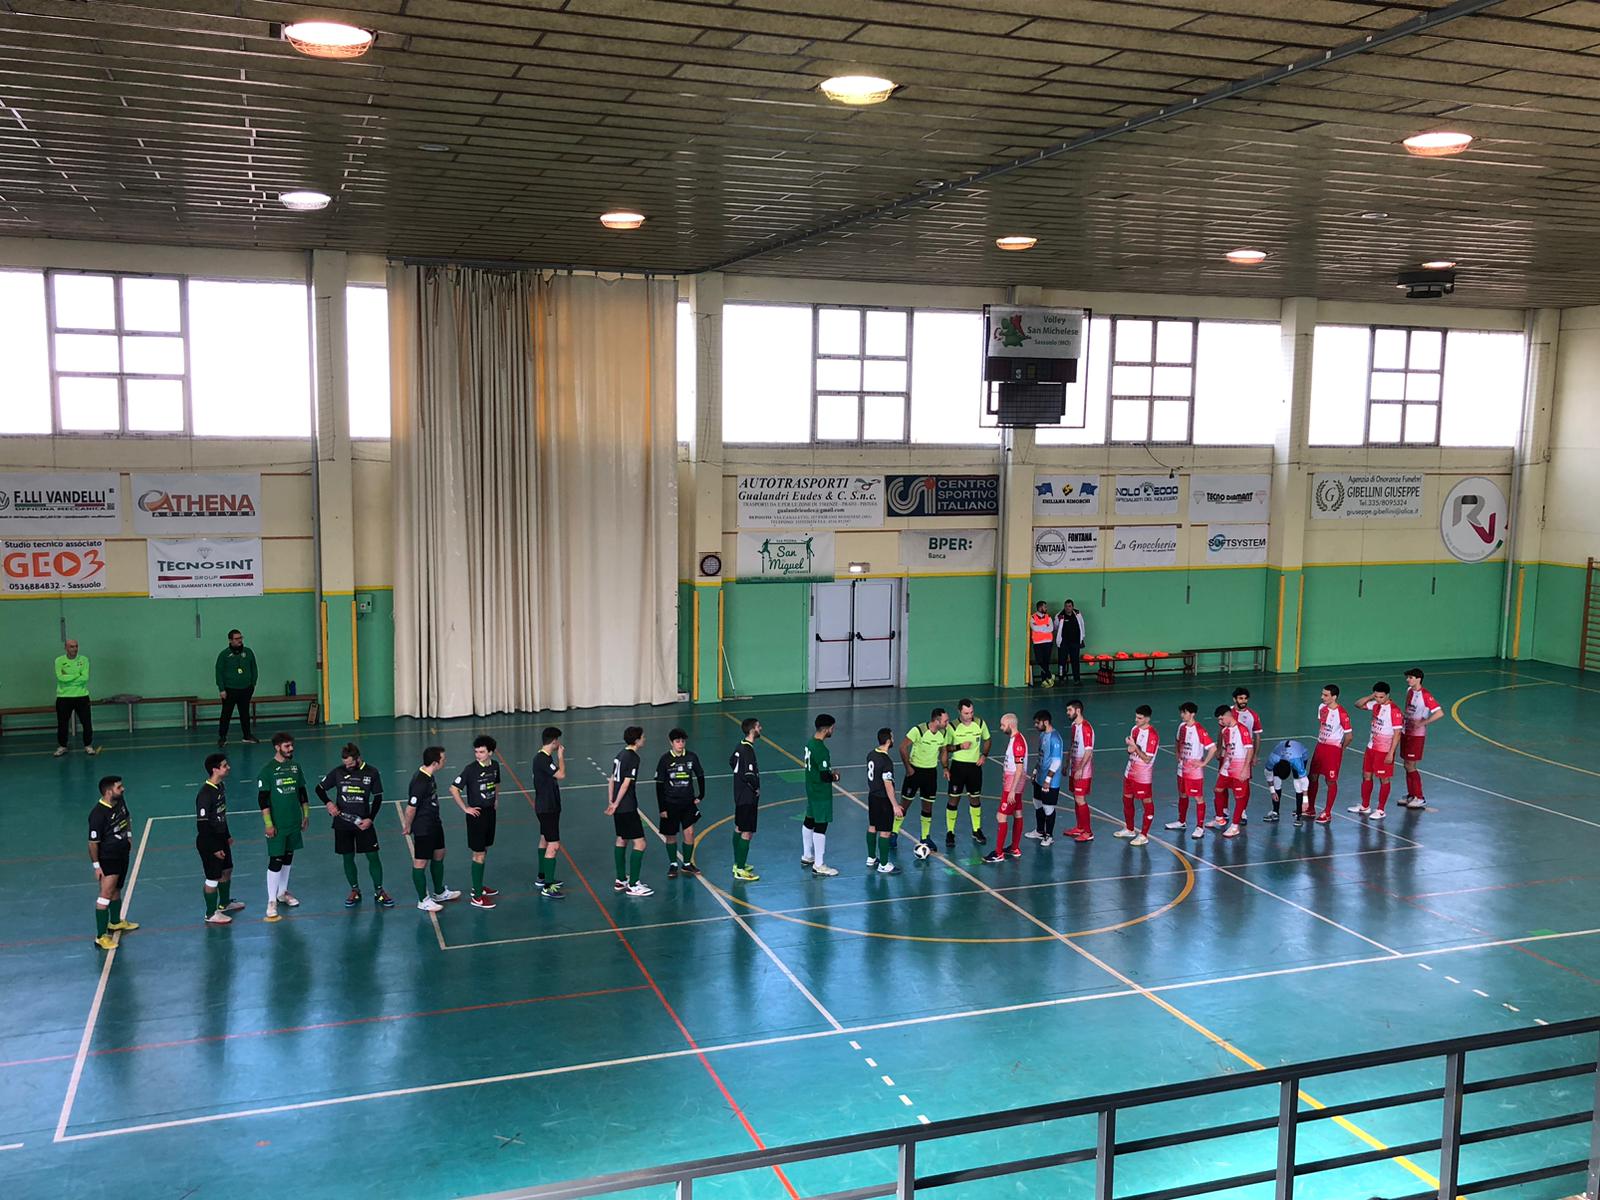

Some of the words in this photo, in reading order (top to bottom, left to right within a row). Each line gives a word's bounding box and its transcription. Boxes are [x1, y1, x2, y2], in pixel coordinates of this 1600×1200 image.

[1043, 315, 1066, 325] Volley
[1043, 326, 1078, 336] Michelese
[739, 478, 849, 489] AUTOTRASPORTI
[937, 480, 997, 489] CENTRO
[738, 491, 789, 501] Gualandri
[792, 491, 822, 501] Eudes
[825, 491, 834, 501] &
[837, 491, 848, 500] C.
[851, 491, 877, 501] S.n.c.
[937, 490, 997, 499] SPORTIVO
[1115, 487, 1140, 496] NOLO
[1153, 486, 1178, 495] 2000
[1346, 486, 1383, 498] GIBELLINI
[1384, 486, 1420, 497] GIUSEPPE
[14, 491, 42, 503] F.LLI
[46, 491, 105, 503] VANDELLI
[158, 492, 255, 512] ATHENA
[1206, 493, 1225, 501] TECNO
[937, 501, 997, 510] ITALIANO
[1068, 533, 1092, 542] FONTANA
[33, 540, 63, 548] tecnico
[1036, 544, 1066, 552] FONTANA
[1114, 540, 1126, 550] La
[1128, 537, 1176, 551] Gnoccheria
[776, 545, 798, 558] San
[157, 559, 253, 572] TECNOSINT
[768, 557, 805, 575] Miguel
[867, 761, 875, 781] 8
